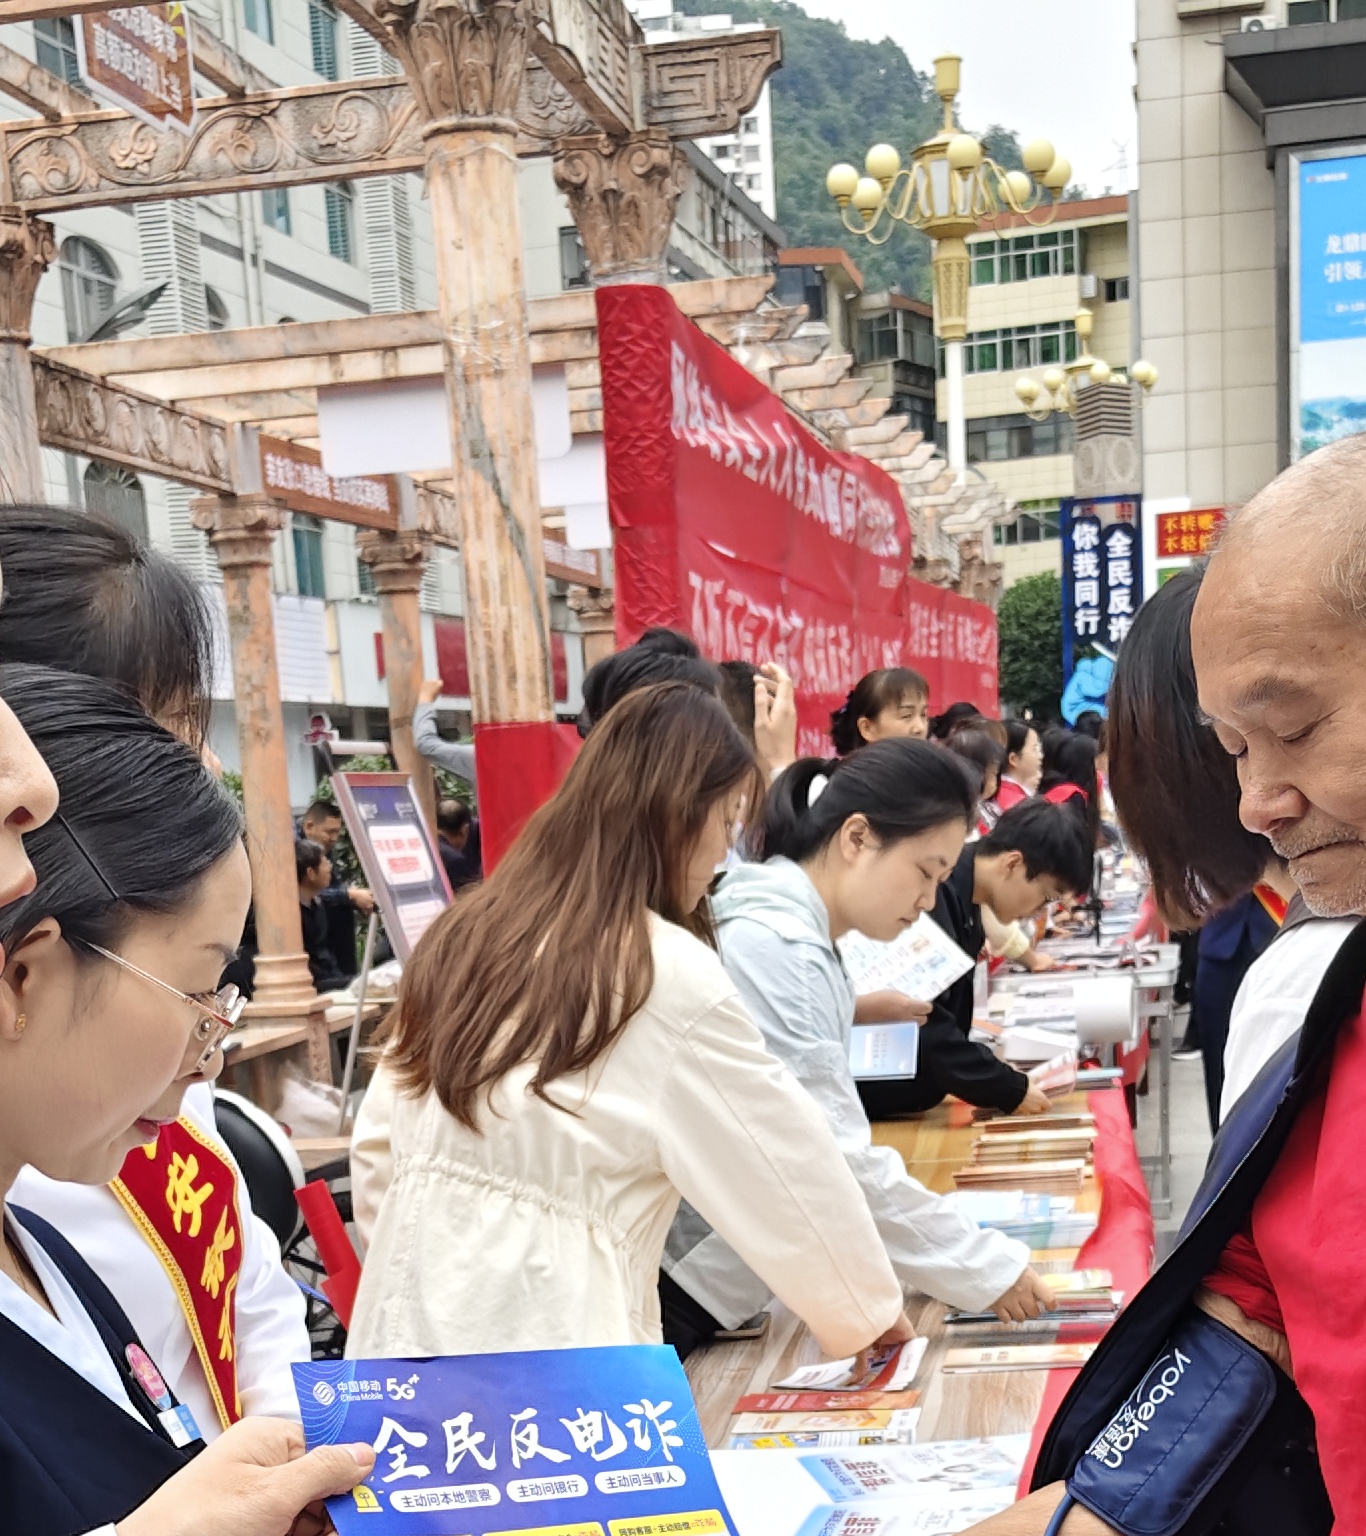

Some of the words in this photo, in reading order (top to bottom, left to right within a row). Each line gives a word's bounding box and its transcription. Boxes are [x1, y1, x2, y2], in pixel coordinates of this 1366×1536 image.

[1071, 521, 1101, 637] 你我同行
[1105, 530, 1134, 643] 全民反诈
[337, 1379, 382, 1394] 中国移动
[1104, 1347, 1191, 1469] yobekan
[372, 1398, 684, 1483] 全民反电诈
[400, 1487, 493, 1508] 主动问本地警察
[516, 1479, 579, 1499] 主动问银行
[605, 1469, 678, 1489] 主动问当事人
